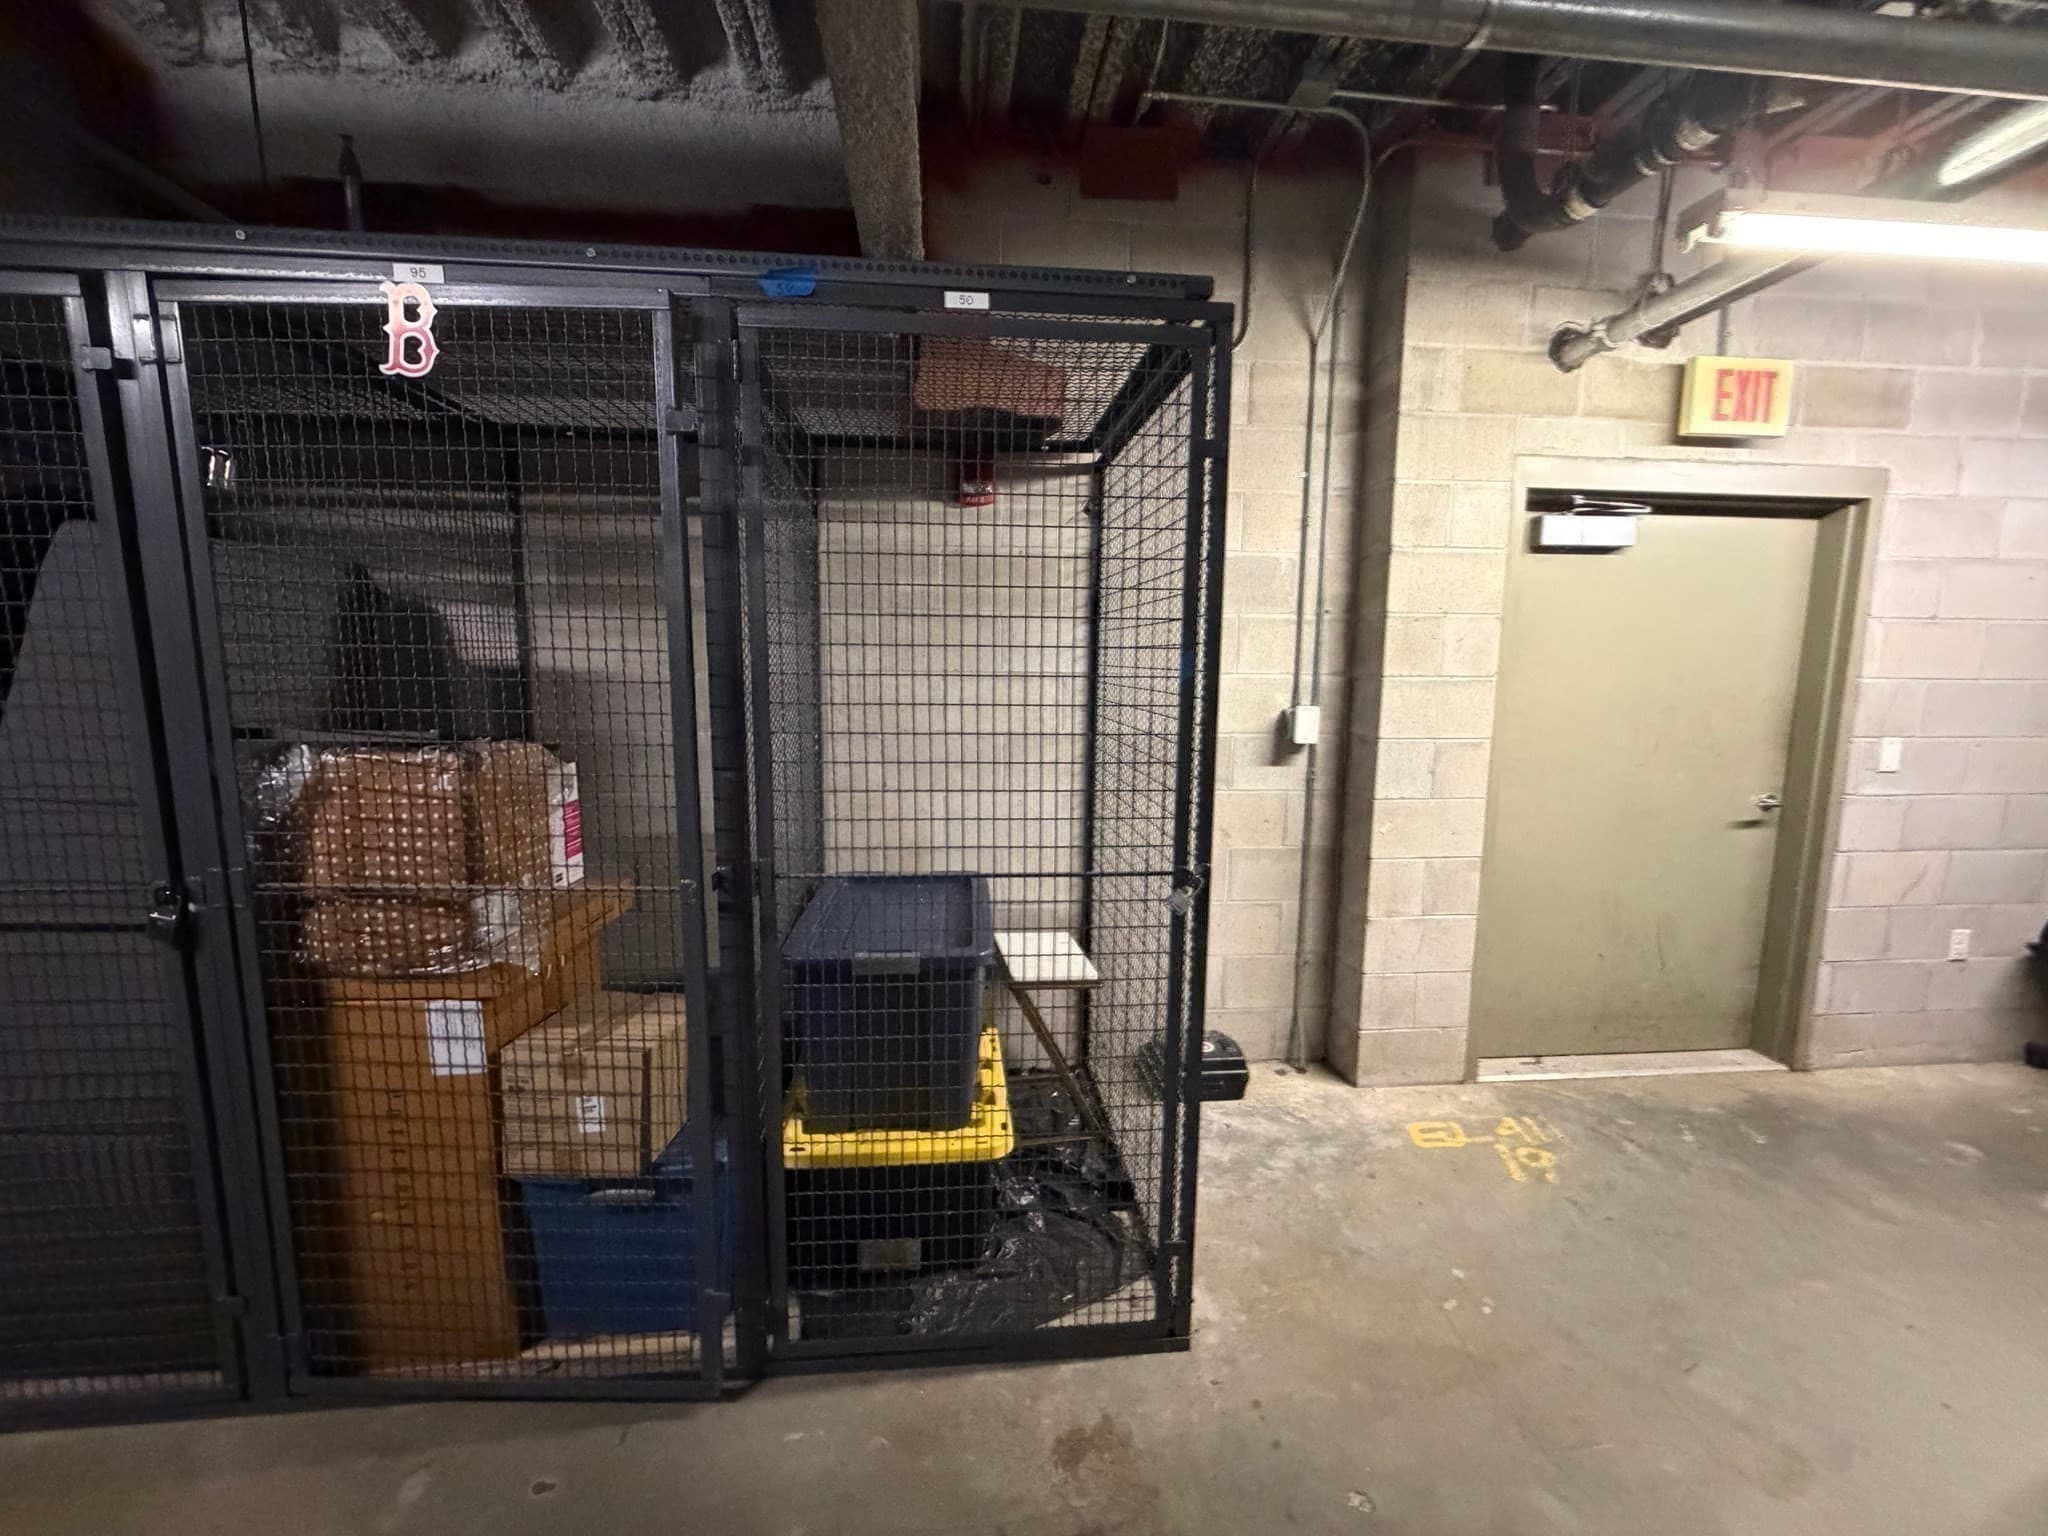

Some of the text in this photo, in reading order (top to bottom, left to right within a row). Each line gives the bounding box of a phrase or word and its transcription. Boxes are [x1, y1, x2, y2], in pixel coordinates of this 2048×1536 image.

[409, 267, 427, 279] 95
[958, 294, 974, 306] 50
[379, 281, 440, 378] B
[1711, 368, 1778, 424] EXIT
